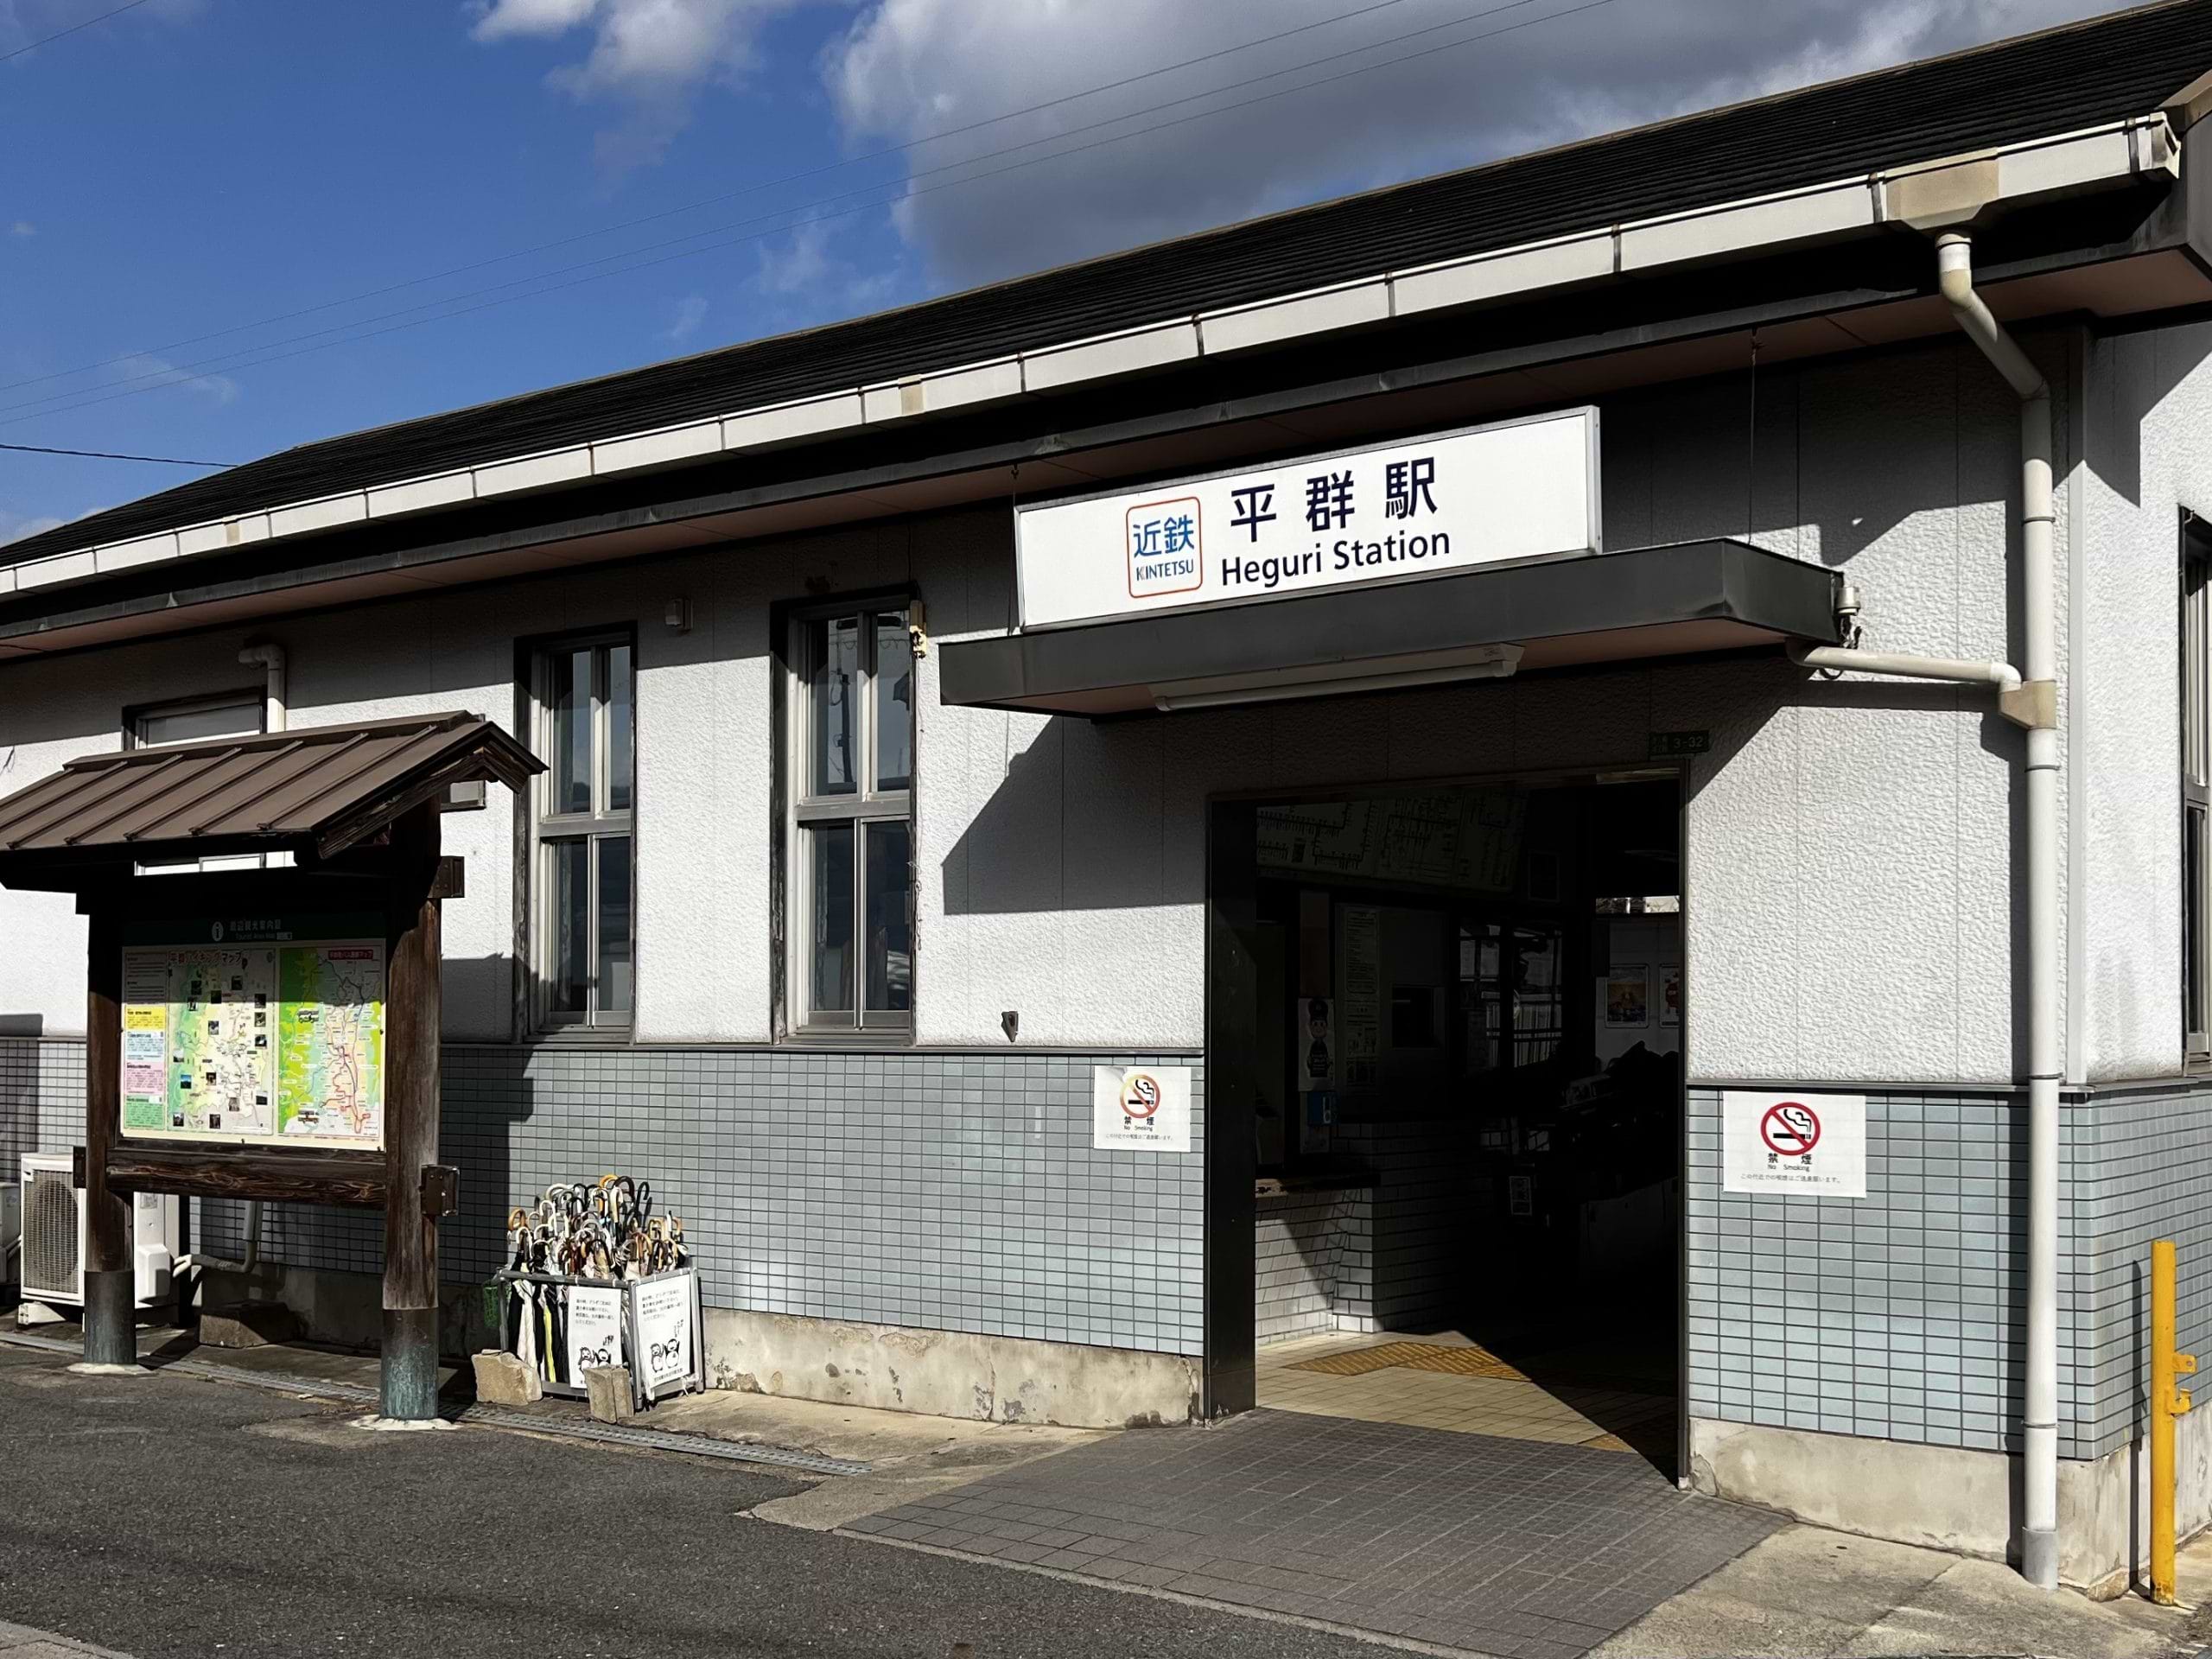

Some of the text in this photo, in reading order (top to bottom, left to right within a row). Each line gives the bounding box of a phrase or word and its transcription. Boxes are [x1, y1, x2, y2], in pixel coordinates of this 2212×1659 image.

[1230, 456, 1438, 543] 平群駅
[1133, 513, 1195, 557] 近鉄
[1135, 558, 1194, 582] KINTETSU
[1222, 530, 1450, 588] Heguri Station
[1783, 1164, 1810, 1173] Smoking
